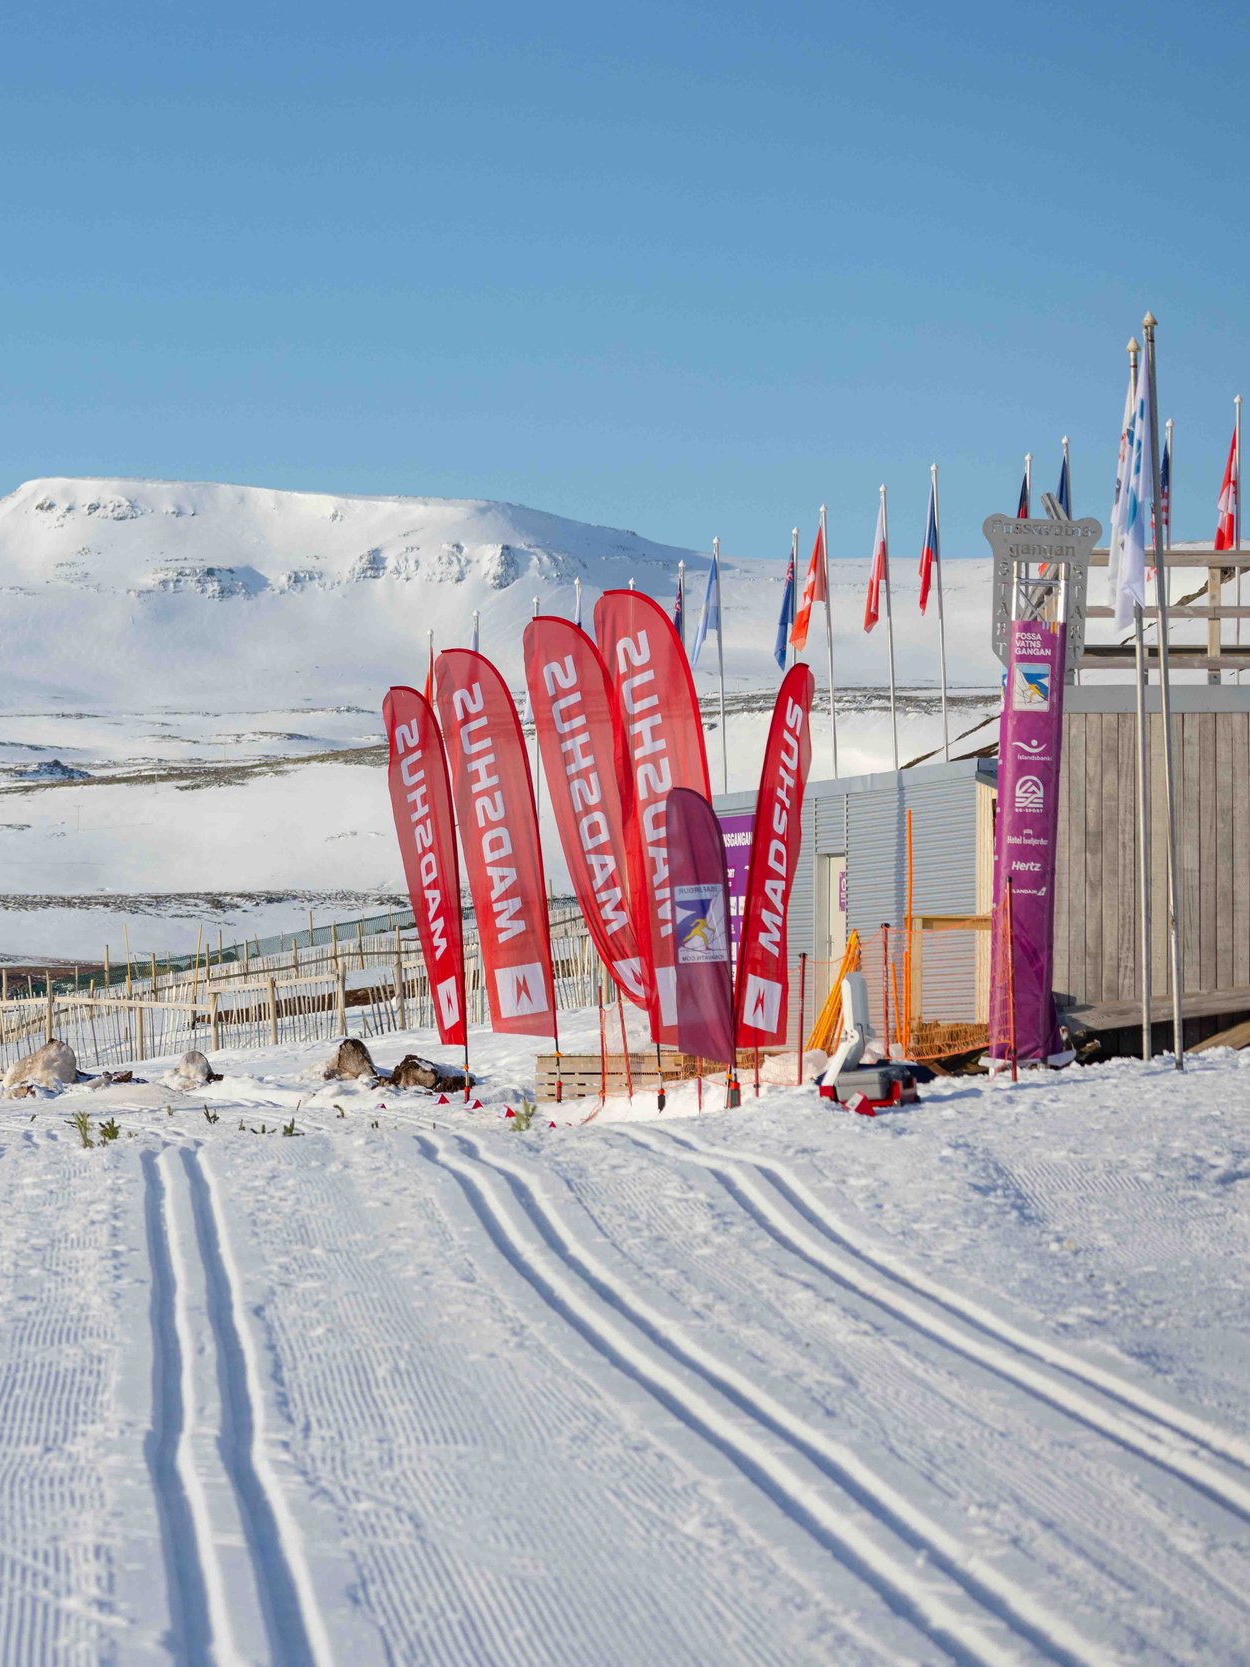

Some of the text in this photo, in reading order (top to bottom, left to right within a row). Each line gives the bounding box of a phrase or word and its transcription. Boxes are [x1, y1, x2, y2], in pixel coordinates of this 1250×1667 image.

[1009, 543, 1077, 559] gangan
[1015, 632, 1042, 640] FOSSA
[1015, 640, 1041, 648] VATNS
[1015, 648, 1052, 656] GANGAN
[758, 697, 803, 958] MADSHUS
[723, 832, 753, 848] NSGANGAN
[1011, 861, 1041, 872] Hertz
